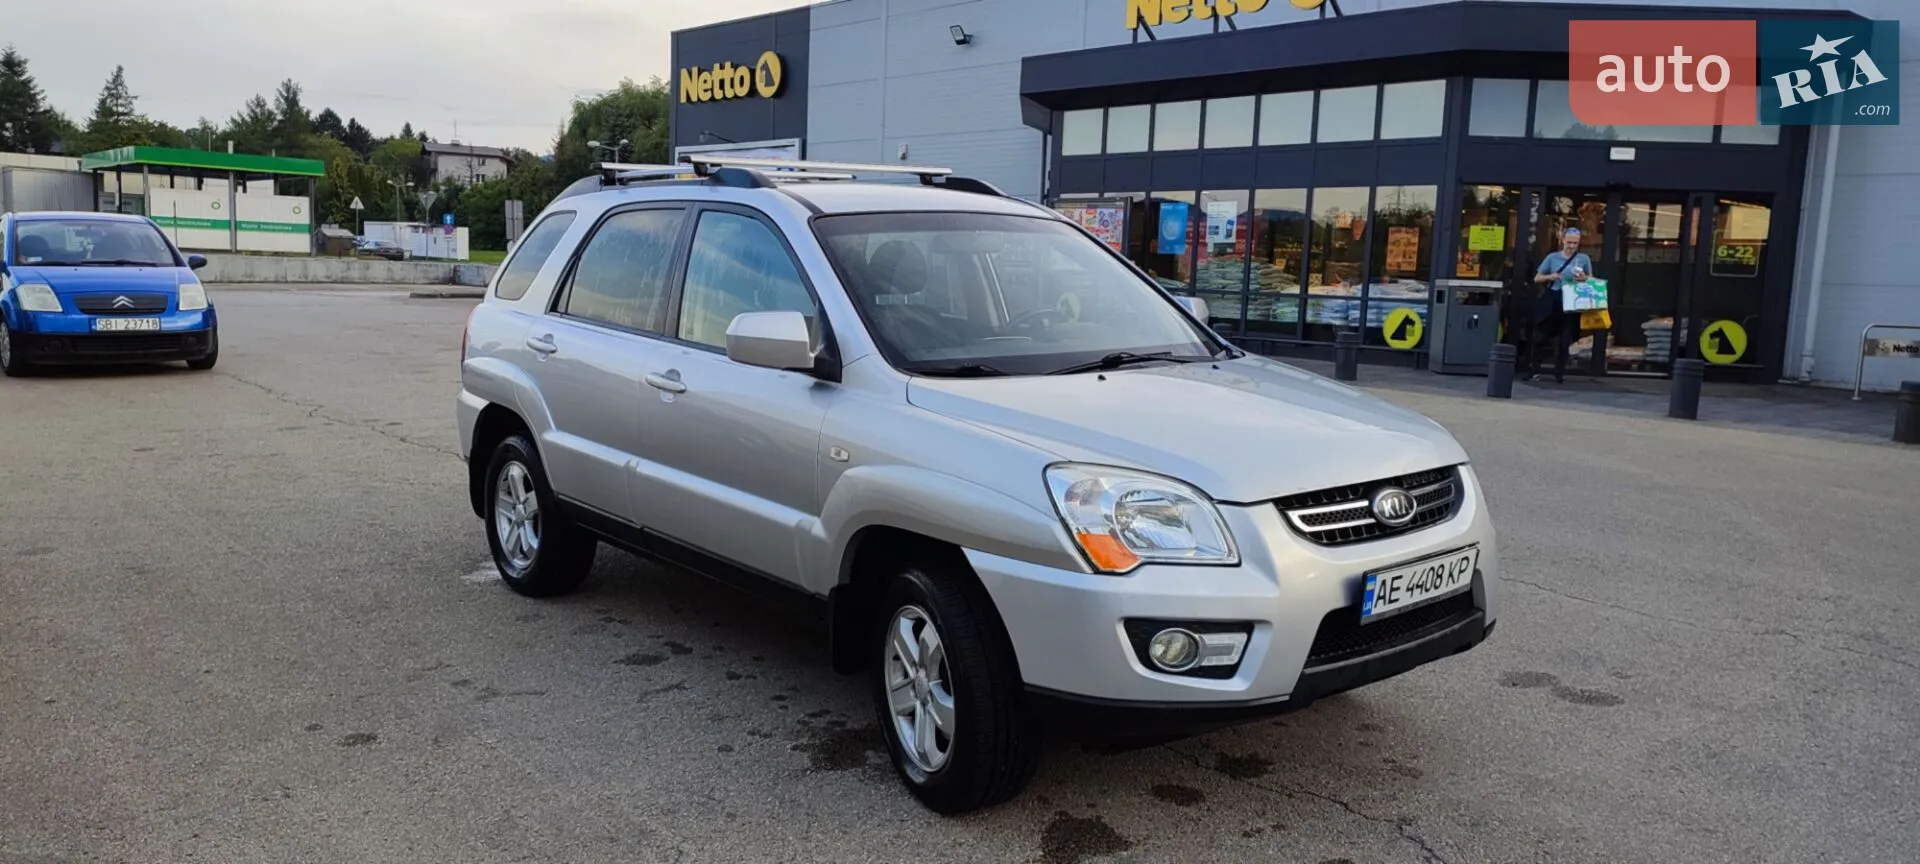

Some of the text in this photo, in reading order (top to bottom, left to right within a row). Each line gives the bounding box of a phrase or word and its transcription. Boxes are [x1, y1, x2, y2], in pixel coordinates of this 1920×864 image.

[680, 61, 750, 103] Netto
[1718, 245, 1753, 257] 6-22
[97, 319, 159, 330] SBI 23718
[1892, 343, 1920, 354] Netto
[1381, 495, 1412, 517] KIA
[1374, 555, 1470, 609] AE 4408 KP
